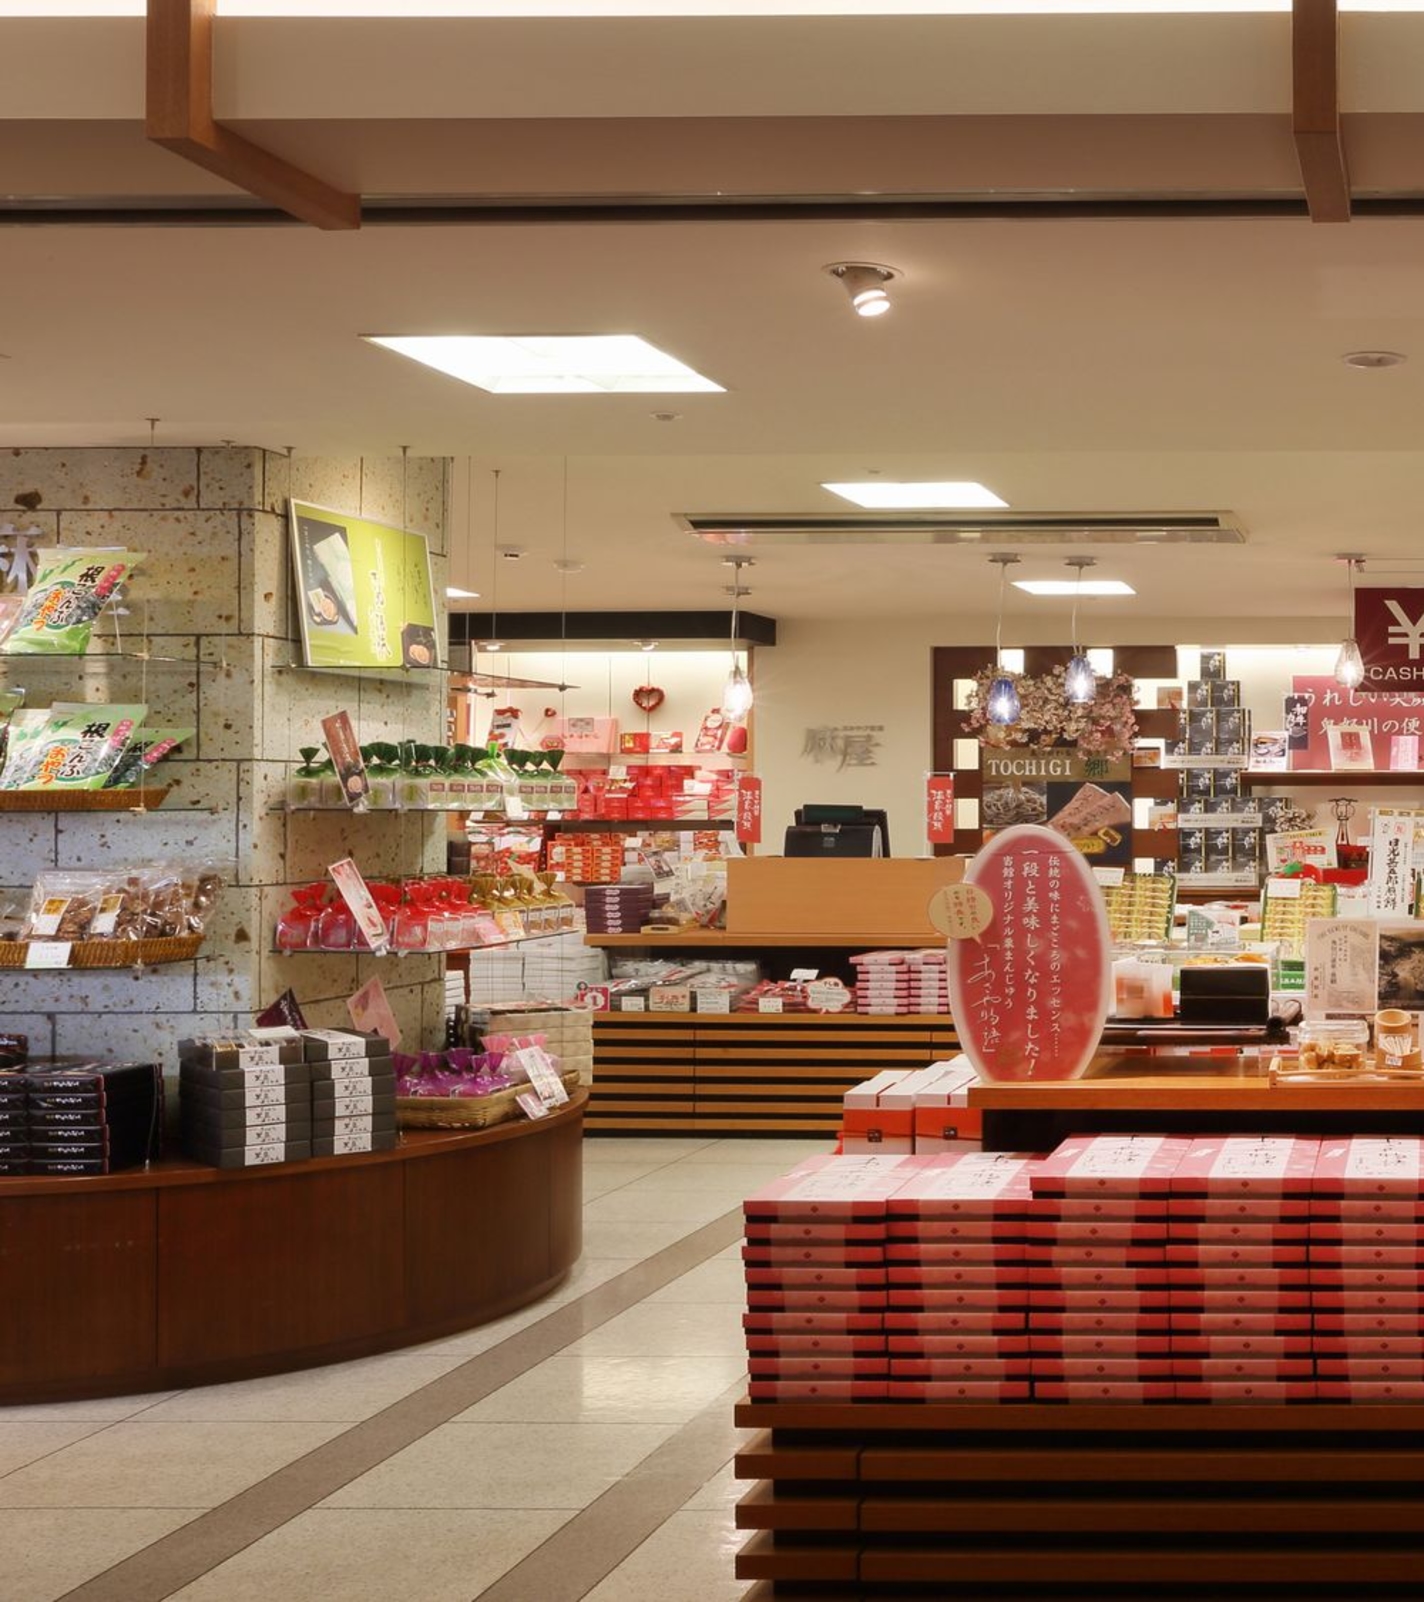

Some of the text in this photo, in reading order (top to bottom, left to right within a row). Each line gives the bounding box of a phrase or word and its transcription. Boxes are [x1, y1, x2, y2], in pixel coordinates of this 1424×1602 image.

[37, 746, 69, 786] おやつ
[987, 759, 1072, 776] TOCHIGI
